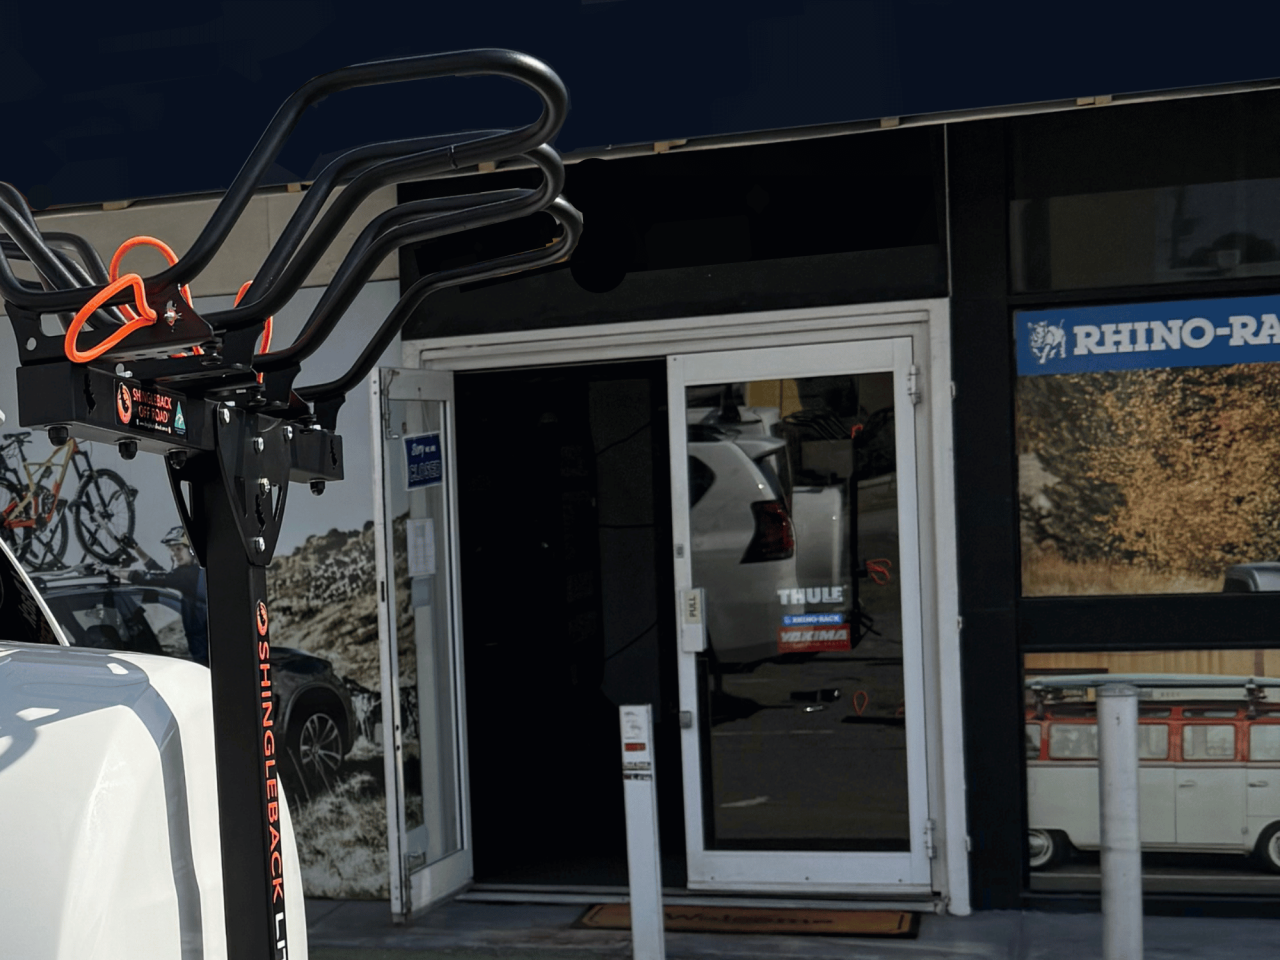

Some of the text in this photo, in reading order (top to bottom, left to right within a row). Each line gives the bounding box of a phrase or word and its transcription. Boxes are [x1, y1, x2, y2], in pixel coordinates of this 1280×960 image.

[1073, 313, 1280, 356] RHINO-RA
[688, 594, 697, 618] PULL
[777, 586, 843, 605] THULE
[781, 629, 847, 642] YAKIMA
[258, 641, 284, 904] SHINGLEBACK
